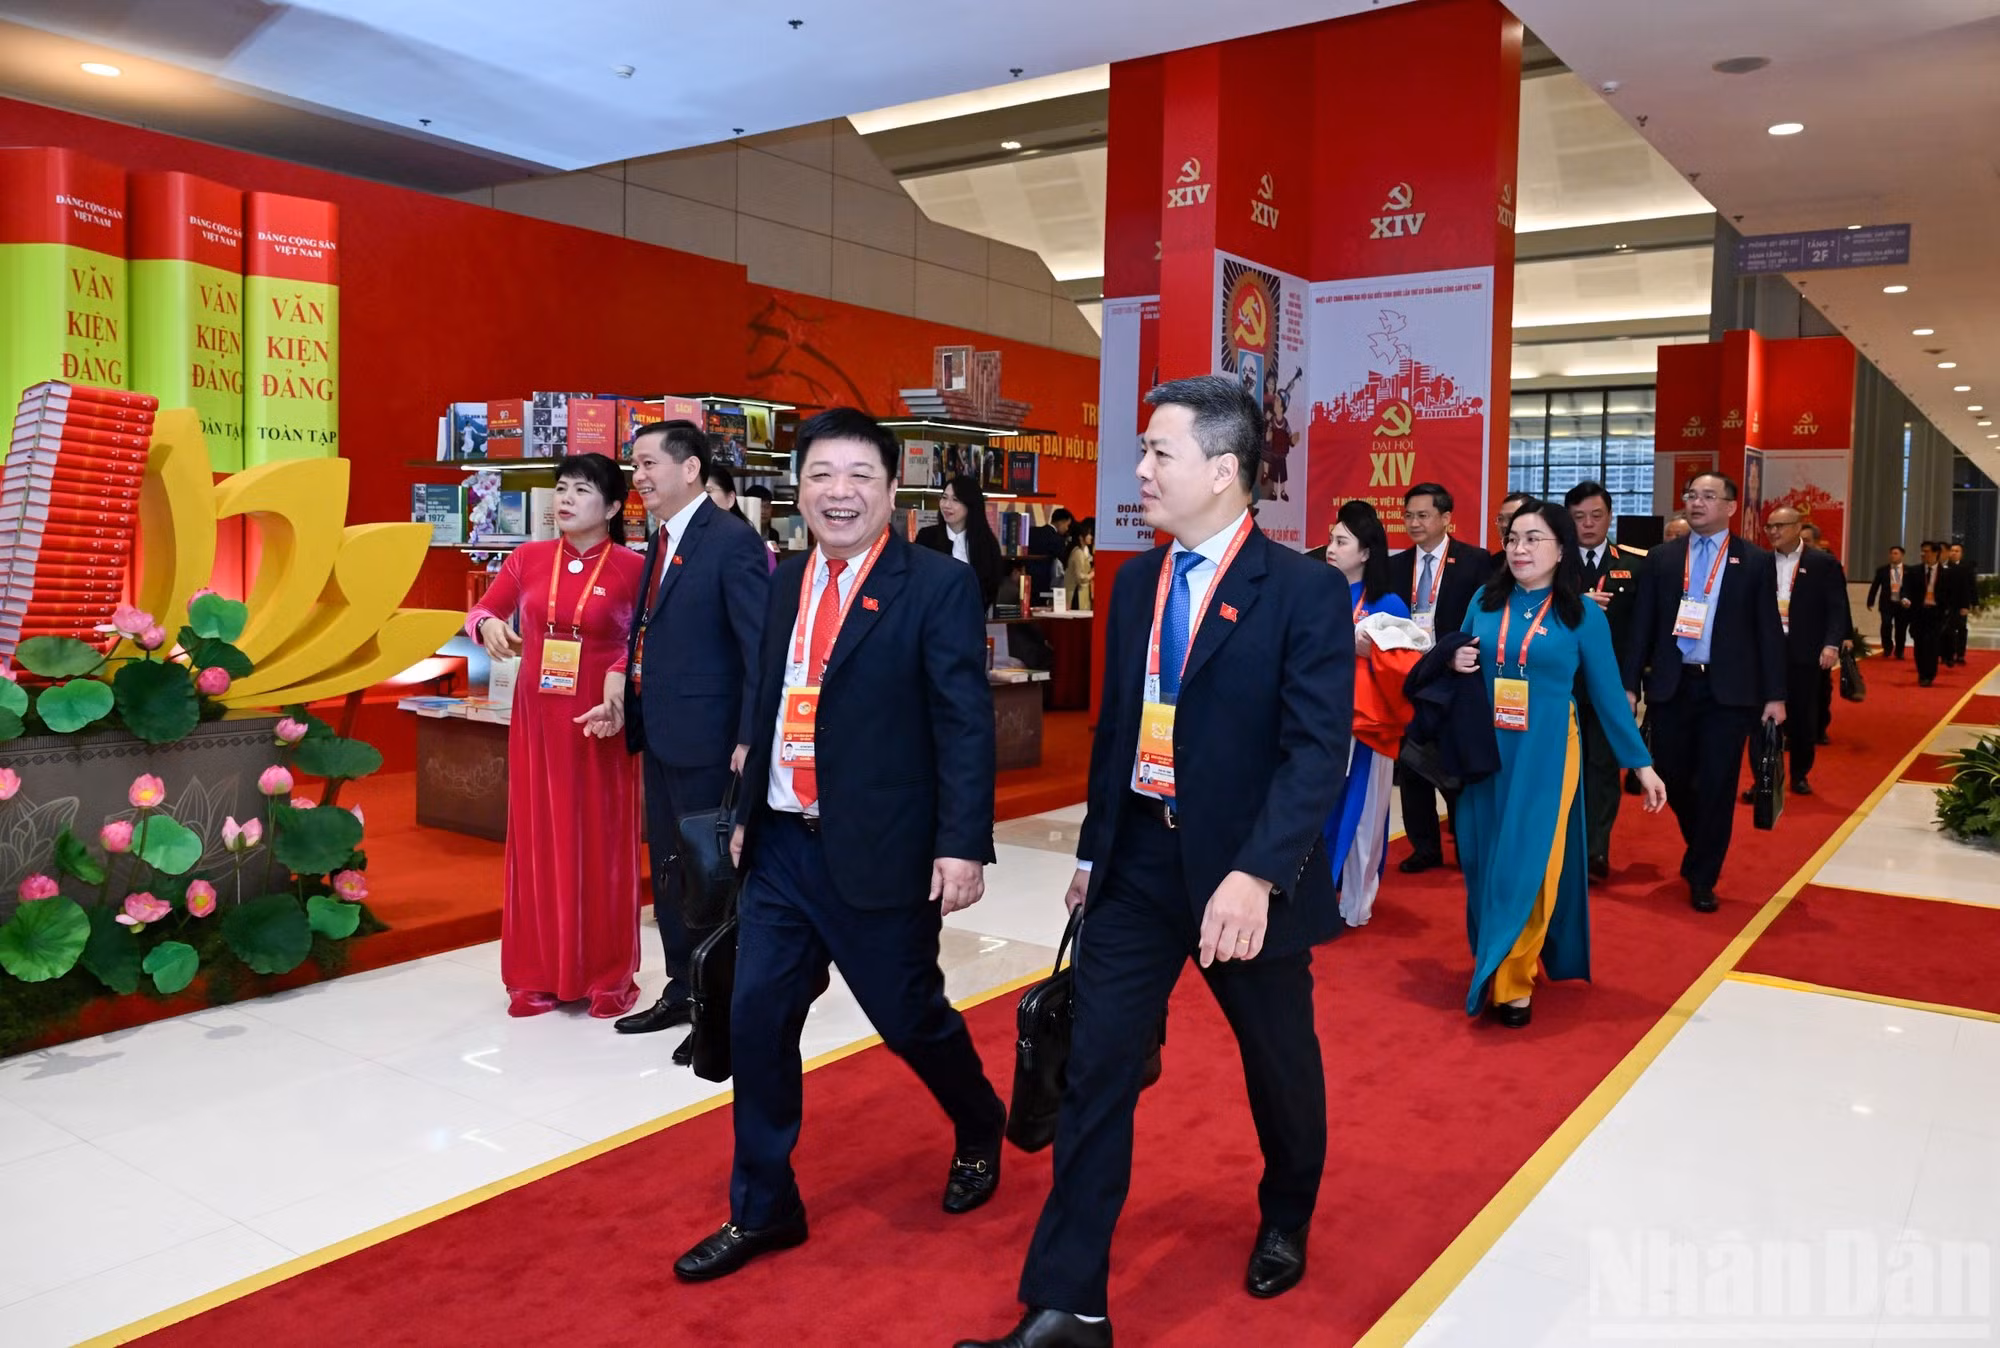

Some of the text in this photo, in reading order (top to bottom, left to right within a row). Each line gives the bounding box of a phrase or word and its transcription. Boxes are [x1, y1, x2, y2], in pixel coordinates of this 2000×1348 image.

[1167, 184, 1211, 208] XIV
[74, 209, 112, 228] VIỆT NAM
[1250, 200, 1279, 230] XIV
[1369, 212, 1426, 240] XIV
[202, 230, 237, 248] VIỆT NAM
[257, 231, 337, 250] ĐẢNG CỘNG SẢN
[274, 244, 322, 259] VIỆT NAM
[1812, 250, 1829, 263] 2F
[71, 266, 113, 301] VĂN
[200, 282, 238, 316] VĂN
[272, 294, 324, 325] VĂN
[67, 311, 118, 347] KIỆN
[196, 324, 240, 359] KIỆN
[267, 335, 329, 368] KIỆN
[60, 347, 122, 385] ĐẢNG
[191, 359, 243, 395] ĐẢNG
[261, 368, 334, 402] ĐẢNG
[225, 423, 243, 441] TẬ
[257, 424, 337, 446] TOÀN TẬP
[1792, 425, 1819, 435] XIV
[1043, 435, 1062, 461] ĐẠI
[1066, 434, 1084, 463] HỘI
[1369, 452, 1416, 486] XIV
[1380, 496, 1396, 507] VIỆT
[428, 514, 445, 522] 1972
[1115, 514, 1129, 527] KỶ
